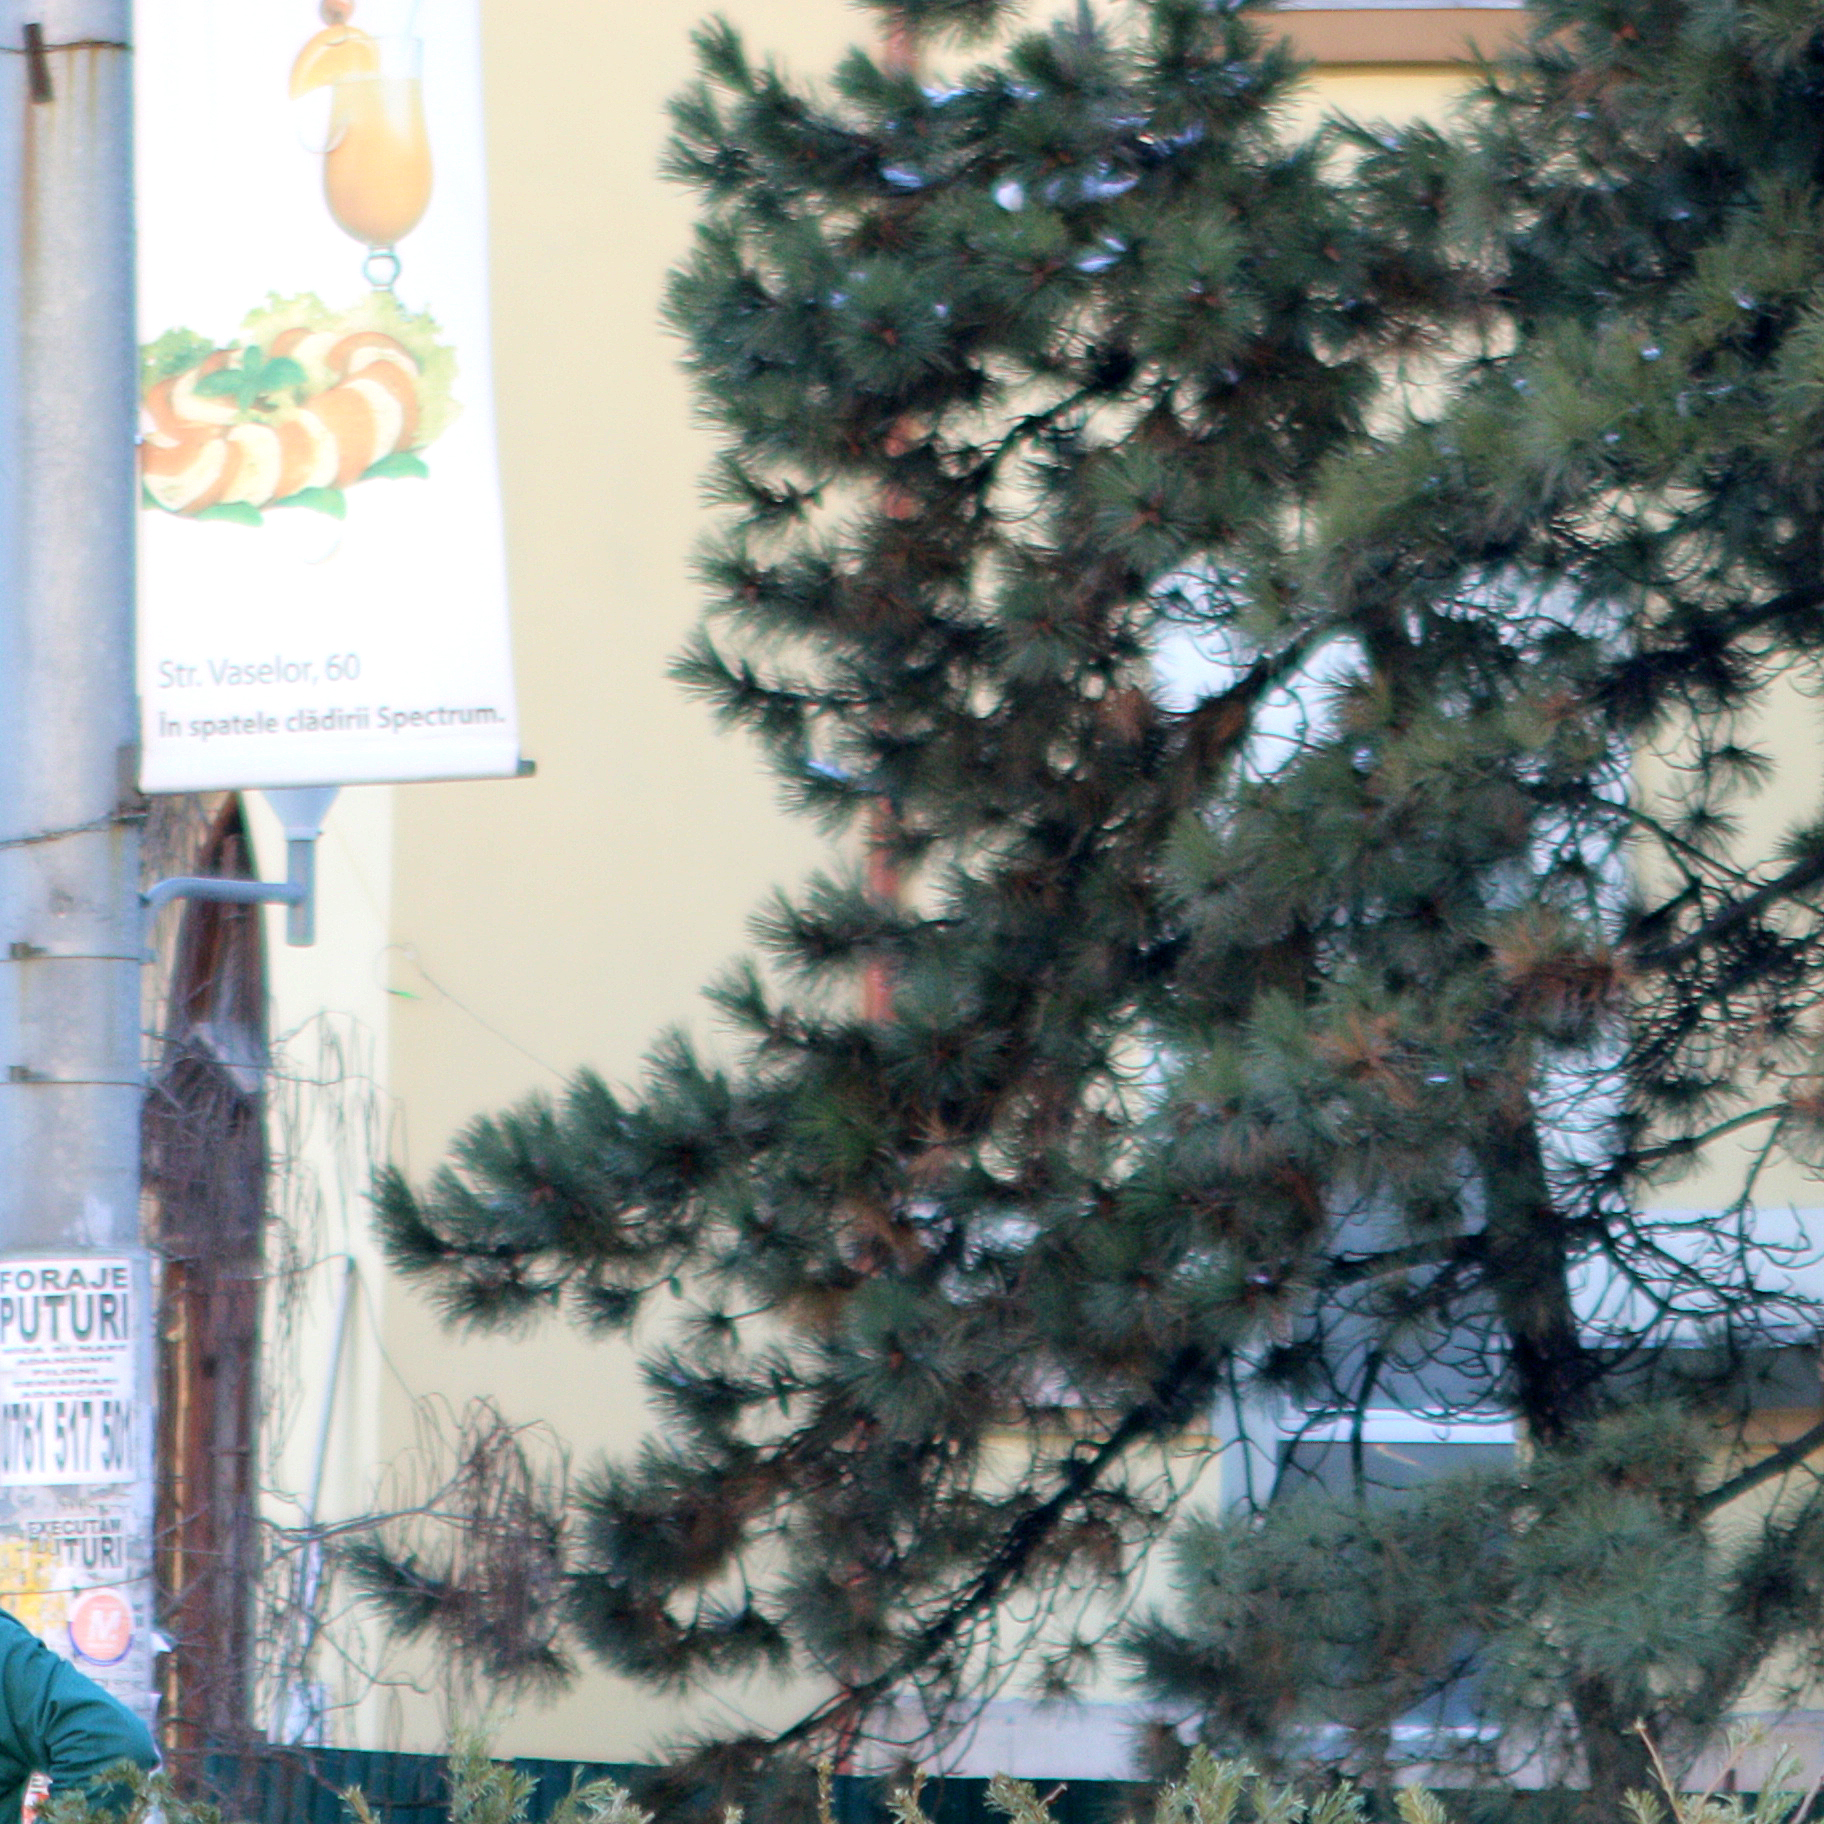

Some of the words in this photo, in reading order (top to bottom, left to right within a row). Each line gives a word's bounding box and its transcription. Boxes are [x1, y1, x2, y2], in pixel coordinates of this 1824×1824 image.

[158, 659, 203, 688] Str.
[207, 655, 319, 687] Vaselor,
[326, 652, 361, 681] 60
[188, 709, 279, 742] spatele
[377, 705, 506, 735] Spectrum.
[0, 1267, 128, 1292] FORAJE
[0, 1293, 128, 1342] PUTURI
[1, 1402, 45, 1473] 0761
[55, 1400, 93, 1473] 517
[102, 1399, 132, 1473] 501
